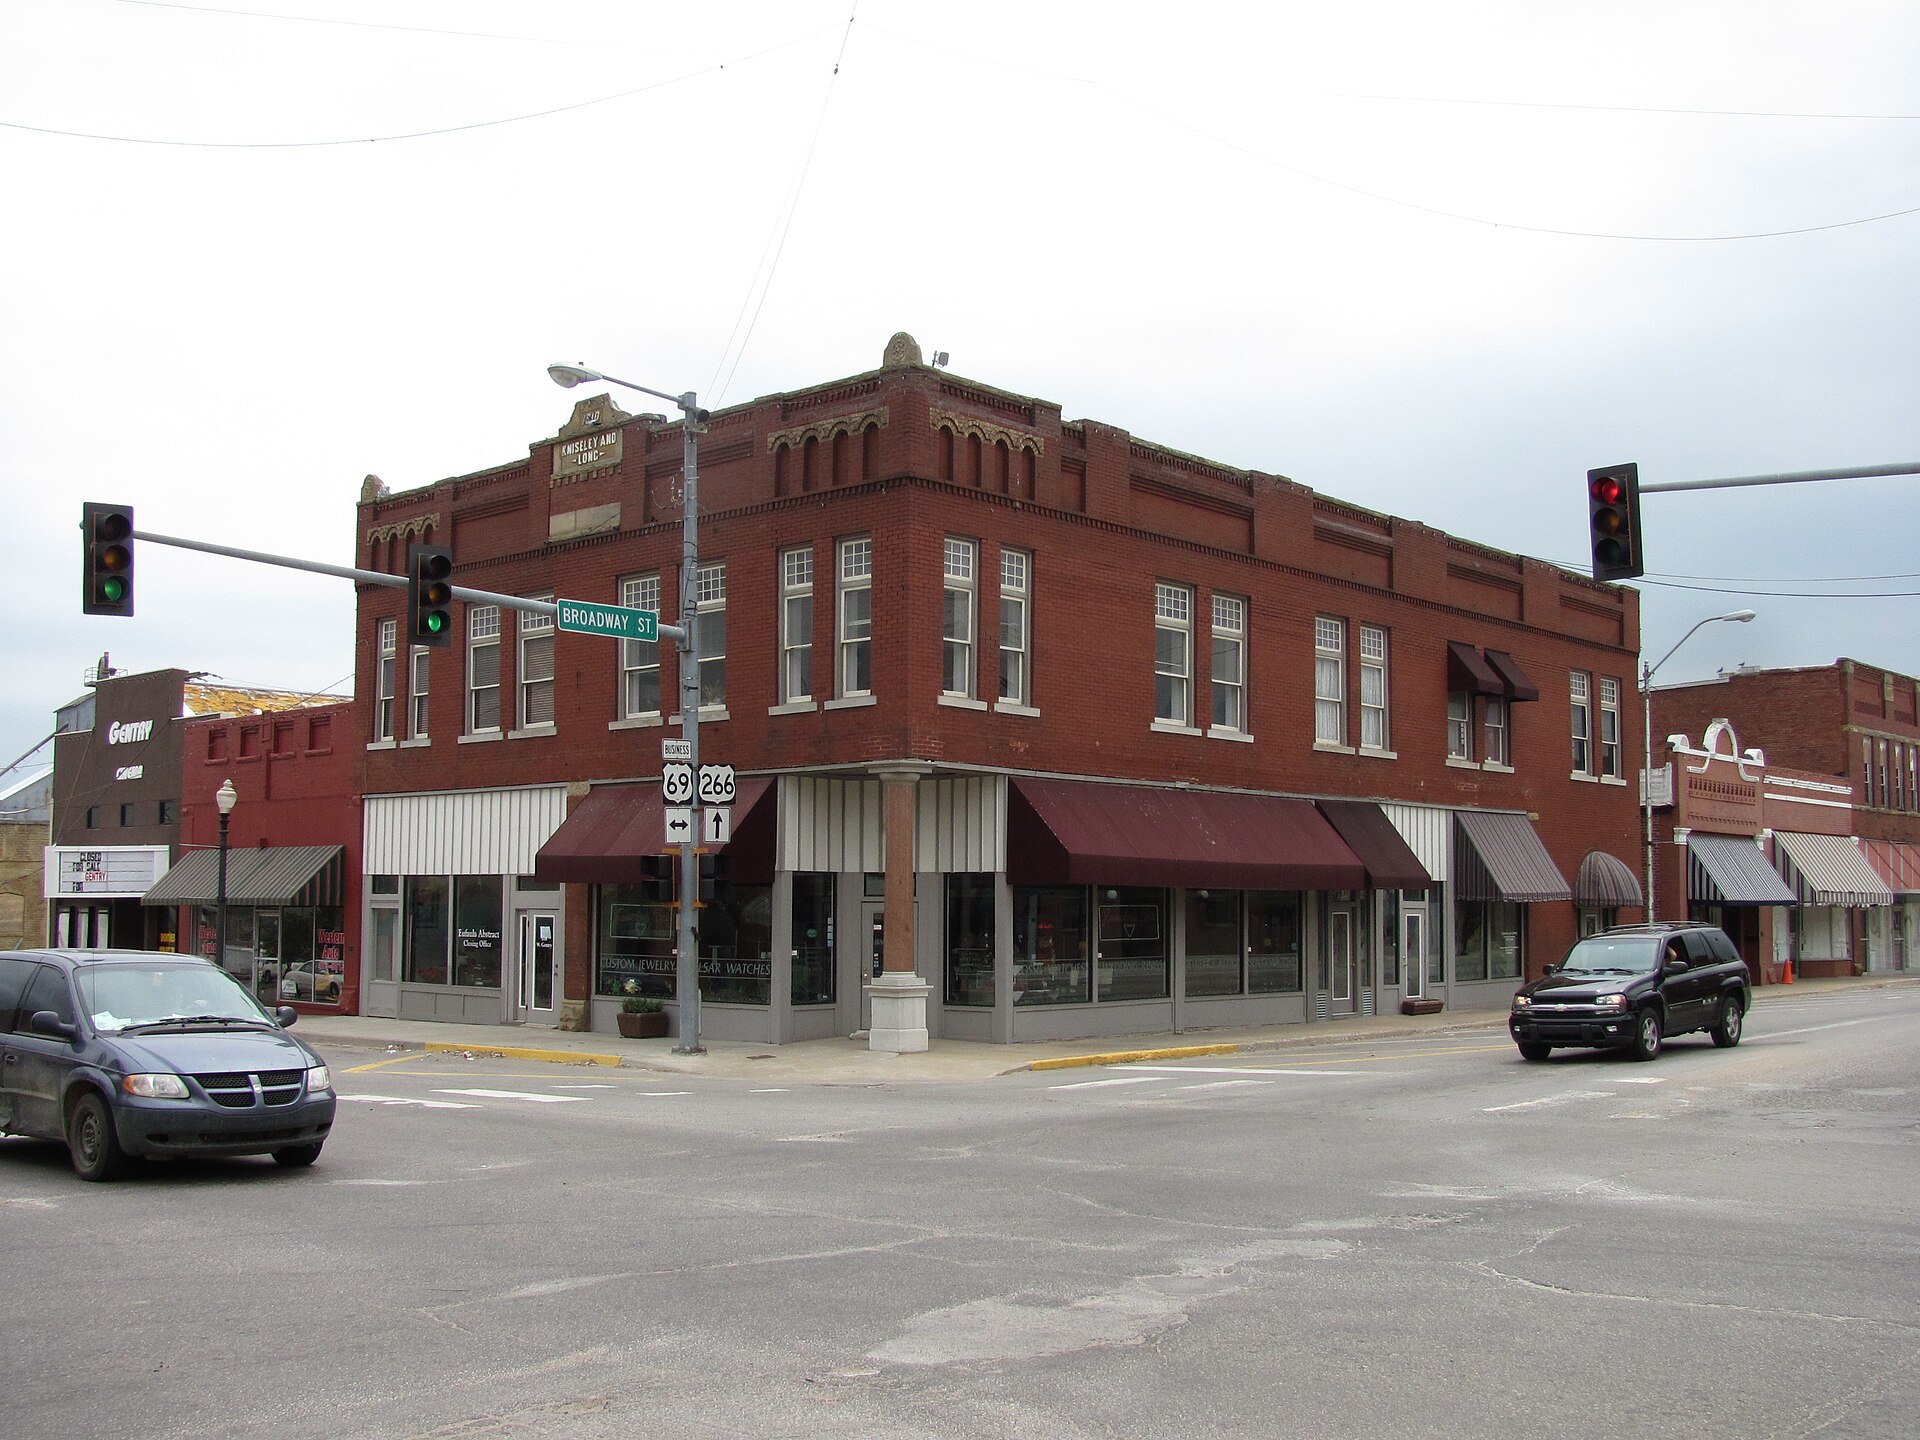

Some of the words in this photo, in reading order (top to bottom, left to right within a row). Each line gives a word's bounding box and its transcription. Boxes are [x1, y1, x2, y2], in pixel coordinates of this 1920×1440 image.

[562, 436, 599, 457] KNISELEY
[600, 432, 617, 447] AND
[578, 450, 599, 465] LONG
[562, 607, 629, 631] BROADWAY
[637, 617, 654, 634] ST.
[665, 744, 690, 755] BUSINESS
[666, 773, 690, 795] 69
[701, 773, 735, 795] 266
[80, 852, 102, 861] CLOSED
[72, 862, 83, 872] FOR
[86, 862, 101, 871] SALE
[85, 872, 107, 882] GENTRY
[458, 928, 478, 938] Eufaula
[478, 928, 500, 939] Abstract
[463, 939, 479, 949] Closing
[479, 939, 492, 948] Office
[321, 944, 339, 960] Auto
[601, 957, 636, 970] CUSTOM
[698, 961, 721, 974] LSAR
[726, 962, 771, 976] WATCHES
